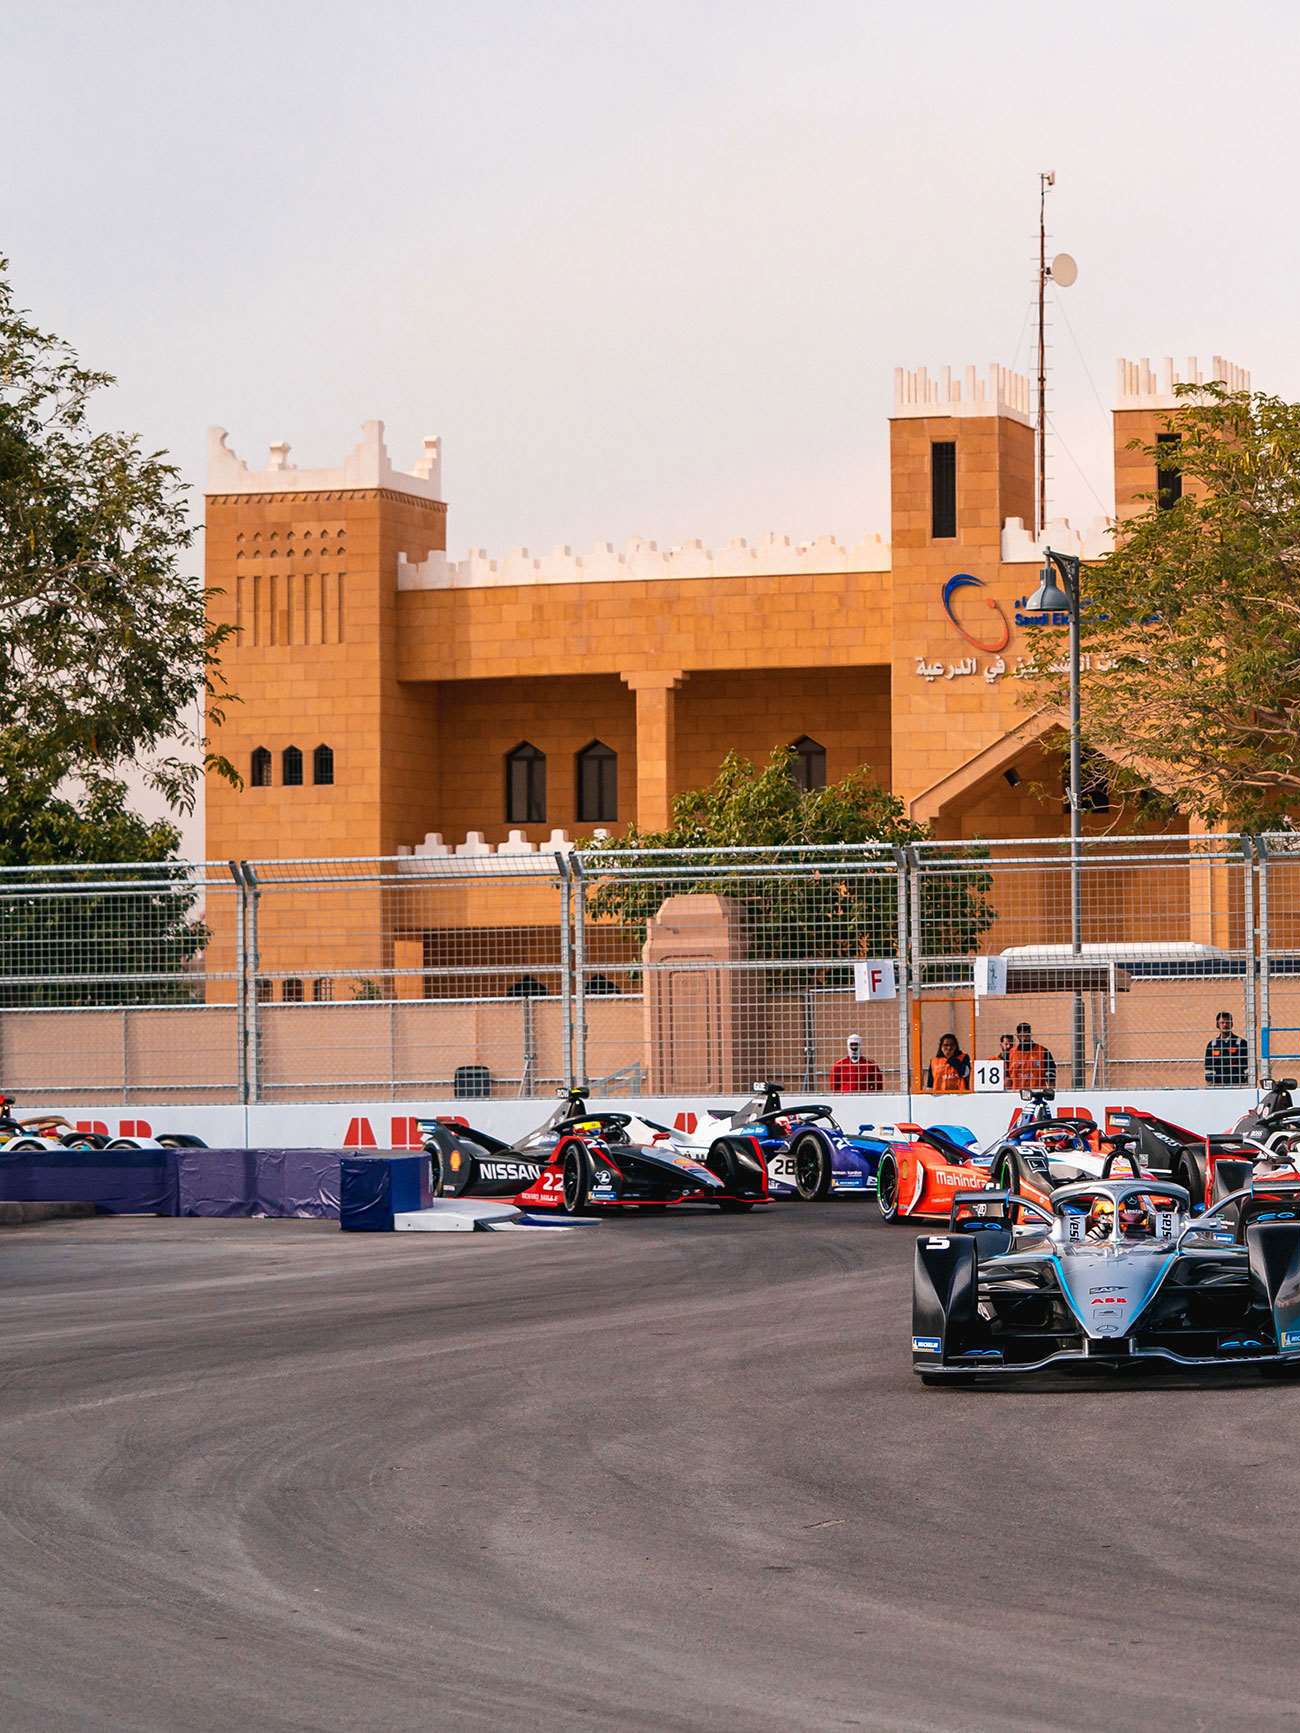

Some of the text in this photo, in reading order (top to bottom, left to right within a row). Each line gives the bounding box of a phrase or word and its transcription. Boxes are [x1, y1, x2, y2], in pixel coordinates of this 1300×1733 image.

[1015, 613, 1049, 626] Saudi
[915, 656, 977, 682] الدرعية
[983, 655, 1006, 683] في
[871, 969, 882, 993] F
[977, 1067, 1000, 1084] 18
[480, 1163, 541, 1180] NISSAN
[774, 1159, 796, 1175] 28
[543, 1172, 564, 1191] 22
[926, 1236, 951, 1250] 5
[1091, 1297, 1128, 1305] ABB
